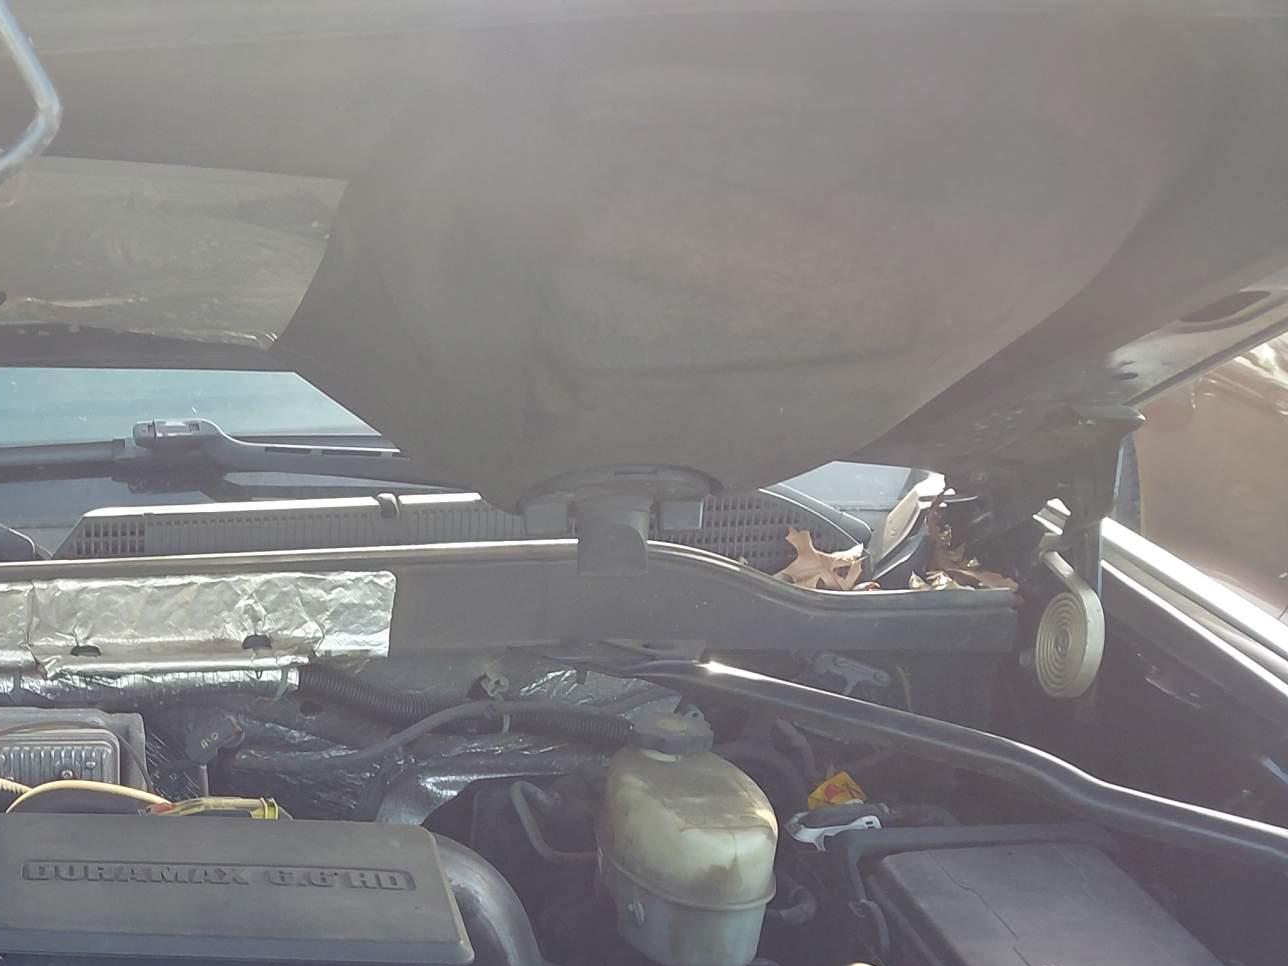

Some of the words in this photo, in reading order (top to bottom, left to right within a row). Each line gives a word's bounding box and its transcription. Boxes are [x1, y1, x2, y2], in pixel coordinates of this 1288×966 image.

[23, 861, 252, 886] DURAMAX
[267, 868, 343, 888] 6.6
[346, 869, 412, 891] HD
